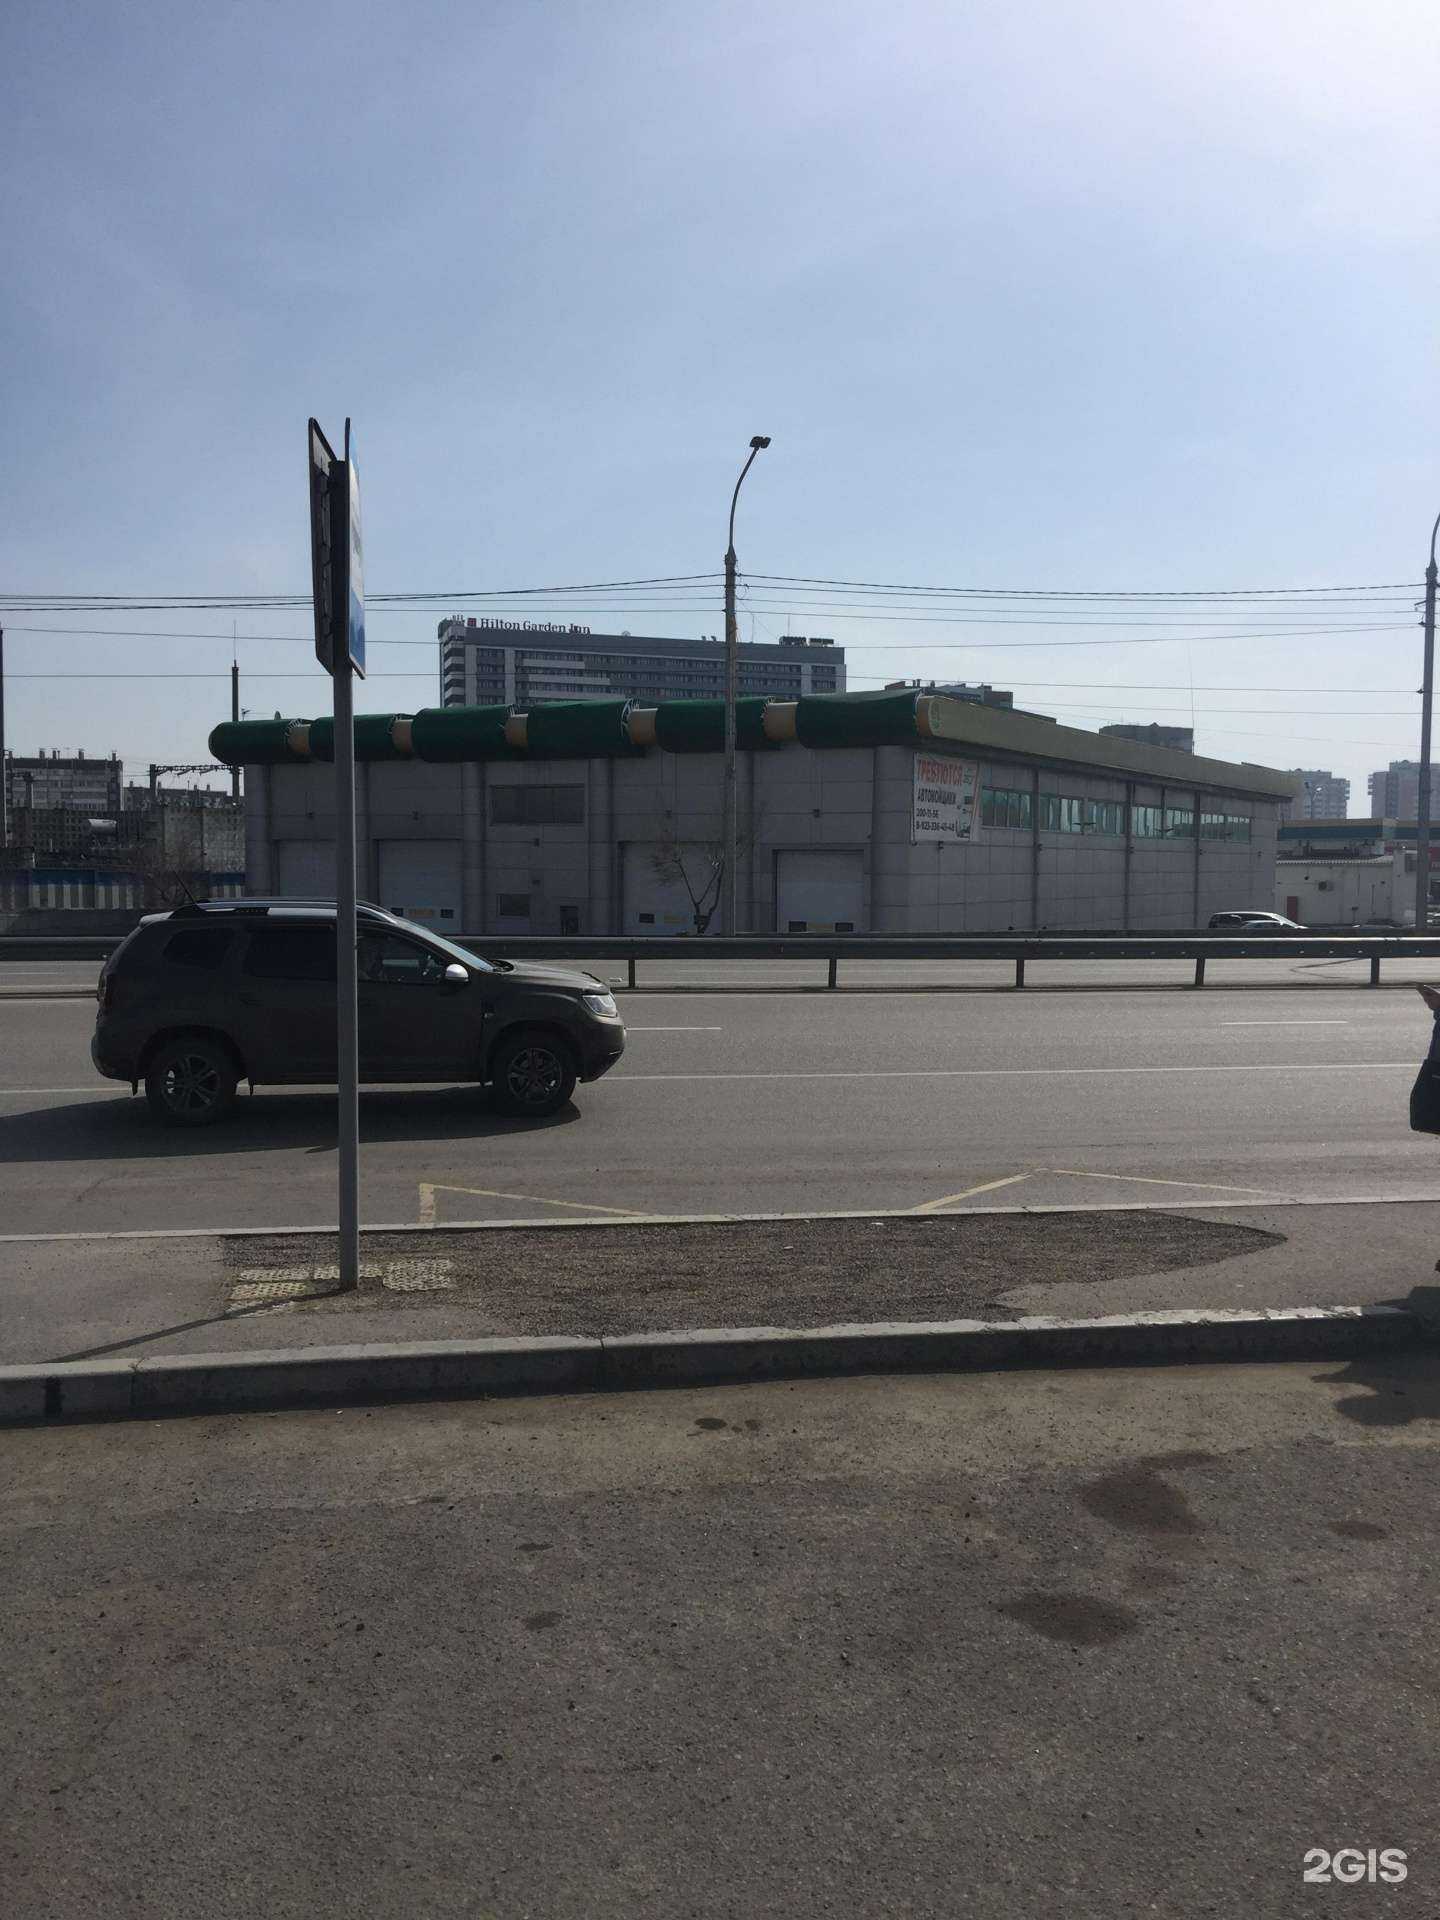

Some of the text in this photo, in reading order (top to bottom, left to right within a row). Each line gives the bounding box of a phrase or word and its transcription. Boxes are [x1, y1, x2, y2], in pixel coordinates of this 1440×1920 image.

[480, 617, 591, 635] Hilton Garden Inn
[918, 759, 962, 786] ТРЕБУЮТСЯ
